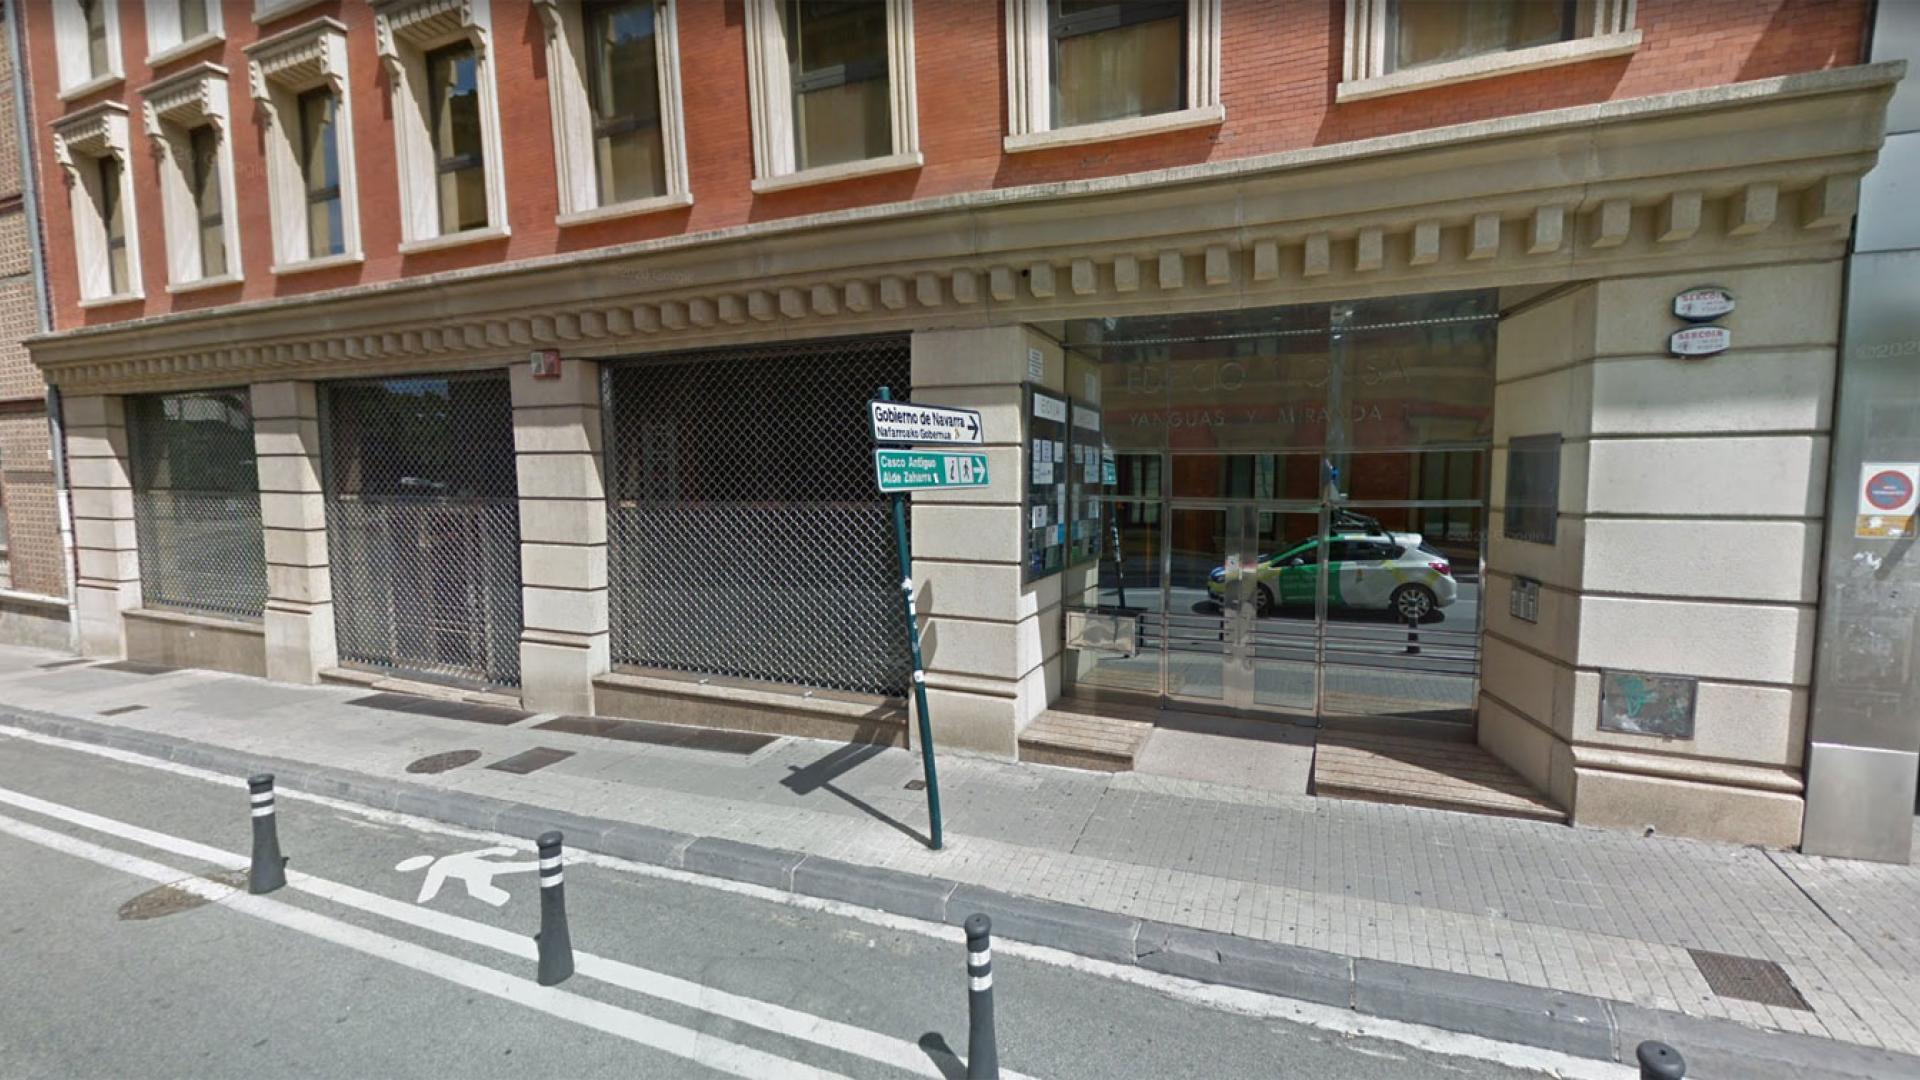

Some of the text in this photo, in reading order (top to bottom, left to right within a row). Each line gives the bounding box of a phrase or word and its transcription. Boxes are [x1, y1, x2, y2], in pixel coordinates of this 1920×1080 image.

[875, 406, 965, 428] Gobierno de Navarra
[1129, 404, 1383, 429] YANGUAS Y MIRADA
[877, 426, 952, 440] Nafarroako Gobernua
[880, 455, 937, 470] Casco Antiguo
[883, 471, 902, 484] Alde
